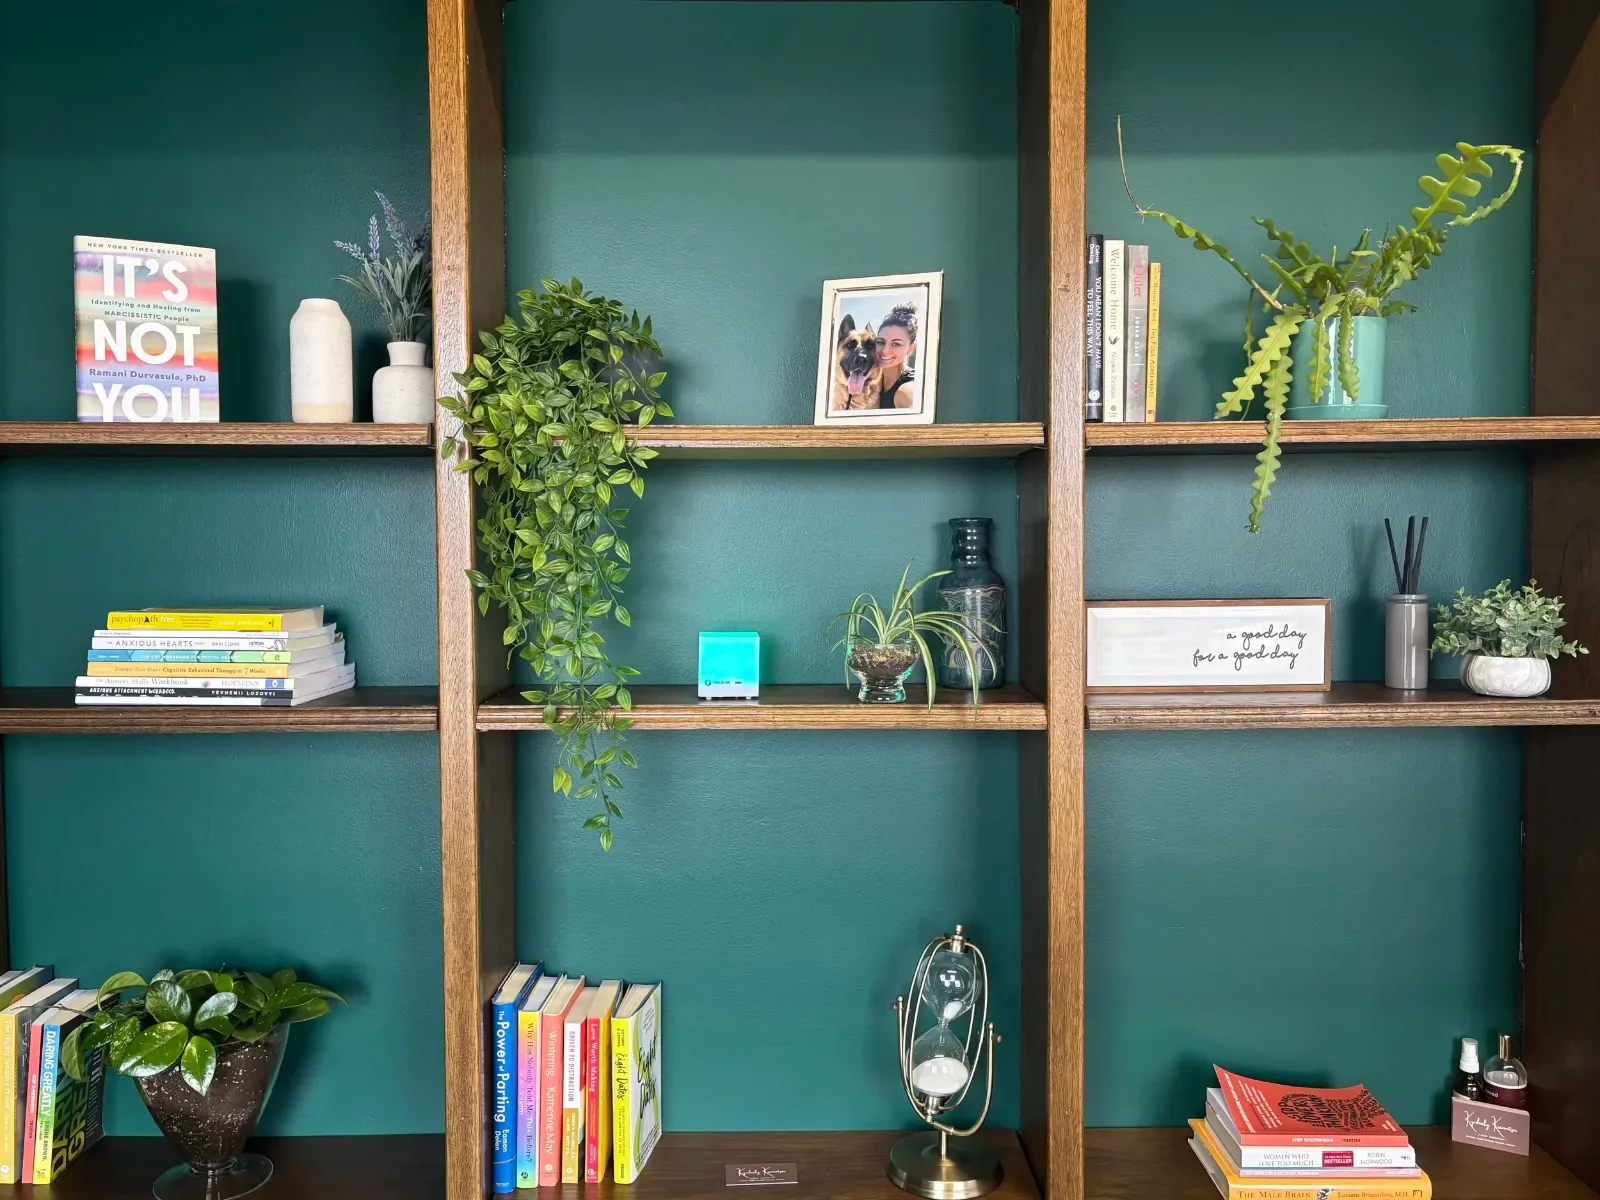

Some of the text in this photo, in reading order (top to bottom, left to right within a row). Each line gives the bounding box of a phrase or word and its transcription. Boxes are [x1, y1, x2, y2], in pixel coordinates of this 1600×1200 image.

[157, 249, 203, 258] BESTSELLER
[102, 254, 188, 303] IT'S
[1110, 248, 1120, 330] Welcome Home
[1133, 264, 1145, 298] Quiet
[91, 299, 135, 308] Identifying
[153, 304, 182, 312] Healing
[1087, 288, 1094, 299] TO
[104, 310, 190, 323] NARCISSISTIC People
[93, 319, 200, 367] NOT
[89, 368, 206, 382] Ramani Durvasula, PhD
[91, 382, 200, 422] YOU
[1242, 624, 1278, 650] good
[1278, 624, 1307, 649] day
[1193, 648, 1215, 667] for
[1234, 644, 1270, 671] good
[1270, 644, 1299, 670] day
[4, 1020, 12, 1033] The
[526, 1022, 534, 1040] Why
[496, 1021, 510, 1065] Power
[590, 1042, 598, 1064] Worth
[525, 1057, 534, 1085] Nobody
[568, 1054, 575, 1062] TO
[41, 1030, 56, 1117] DARING GREATLY
[589, 1066, 598, 1093] Making
[615, 1052, 628, 1101] Eight Dates
[494, 1073, 510, 1123] Parting
[544, 1030, 558, 1154] Wintering Katherine May
[526, 1104, 533, 1116] Me
[525, 1135, 533, 1163] Before?
